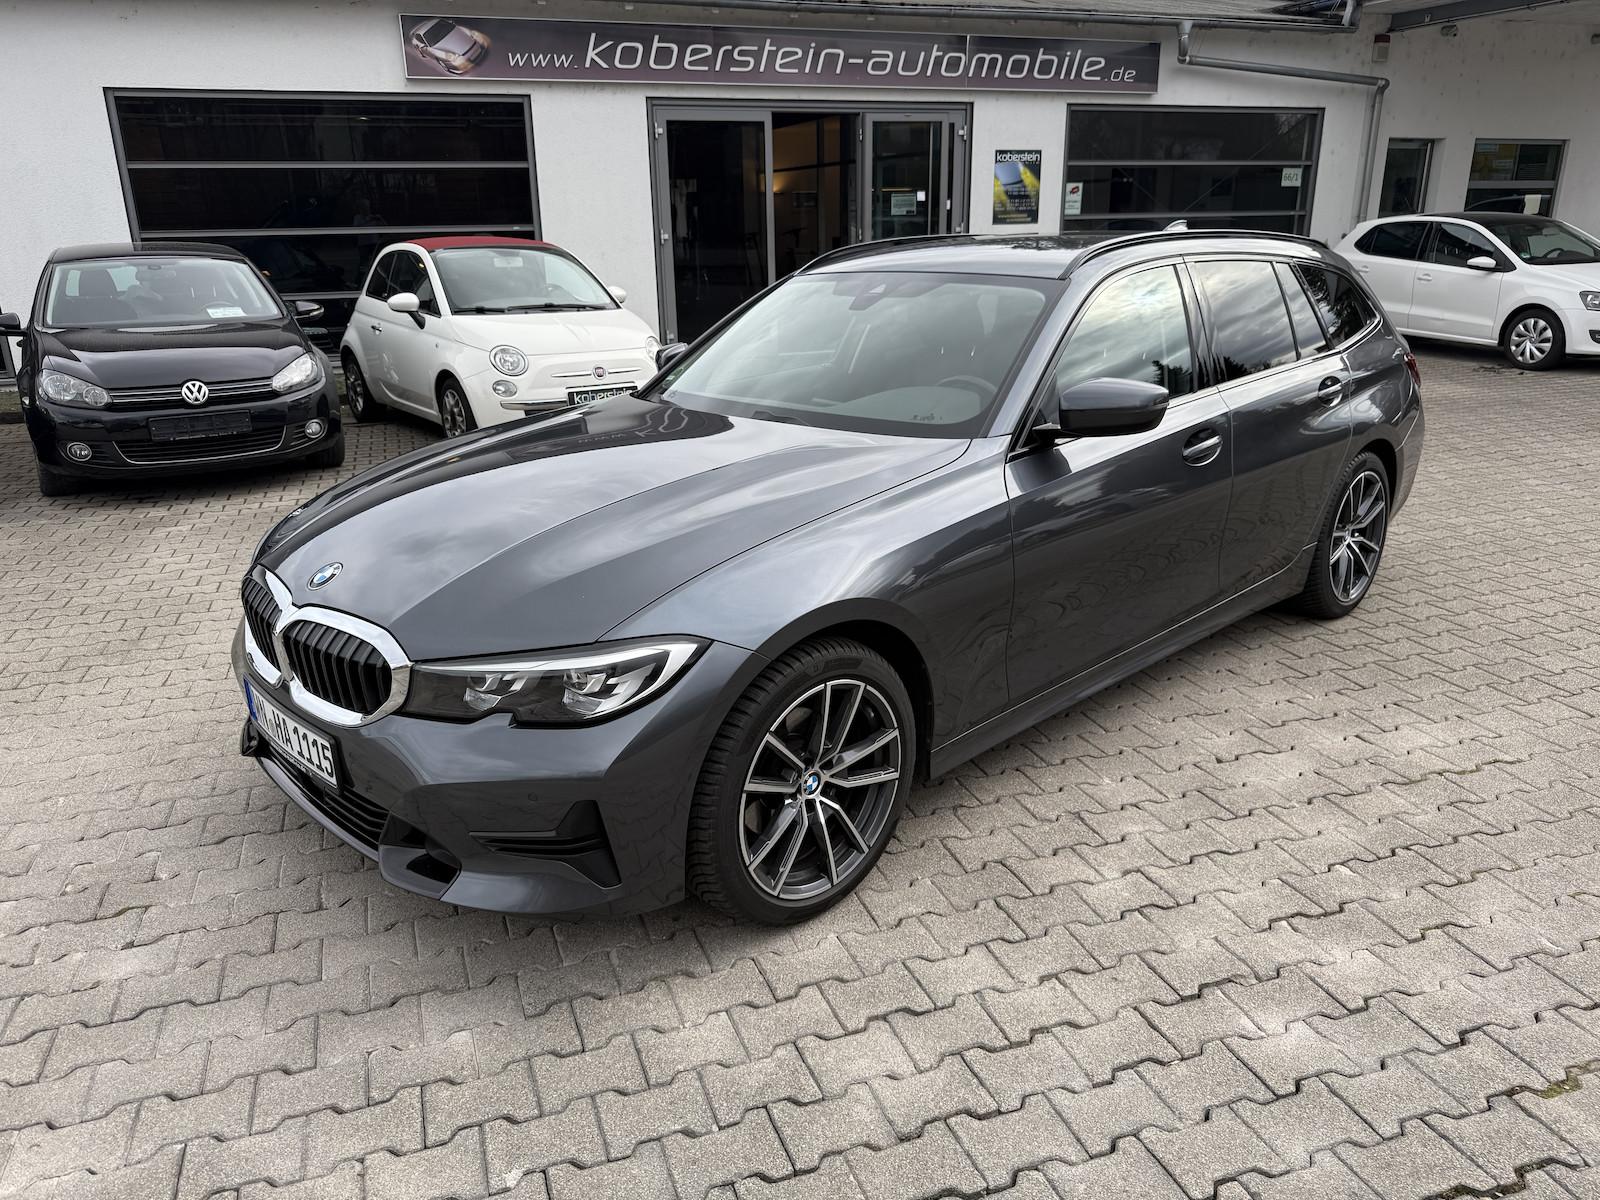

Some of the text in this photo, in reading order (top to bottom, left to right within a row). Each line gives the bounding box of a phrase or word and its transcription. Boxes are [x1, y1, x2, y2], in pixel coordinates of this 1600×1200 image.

[508, 32, 1136, 82] www.koberstein-automobile.de
[996, 152, 1040, 161] koberstein
[272, 709, 294, 751] HA
[293, 726, 334, 778] 1115
